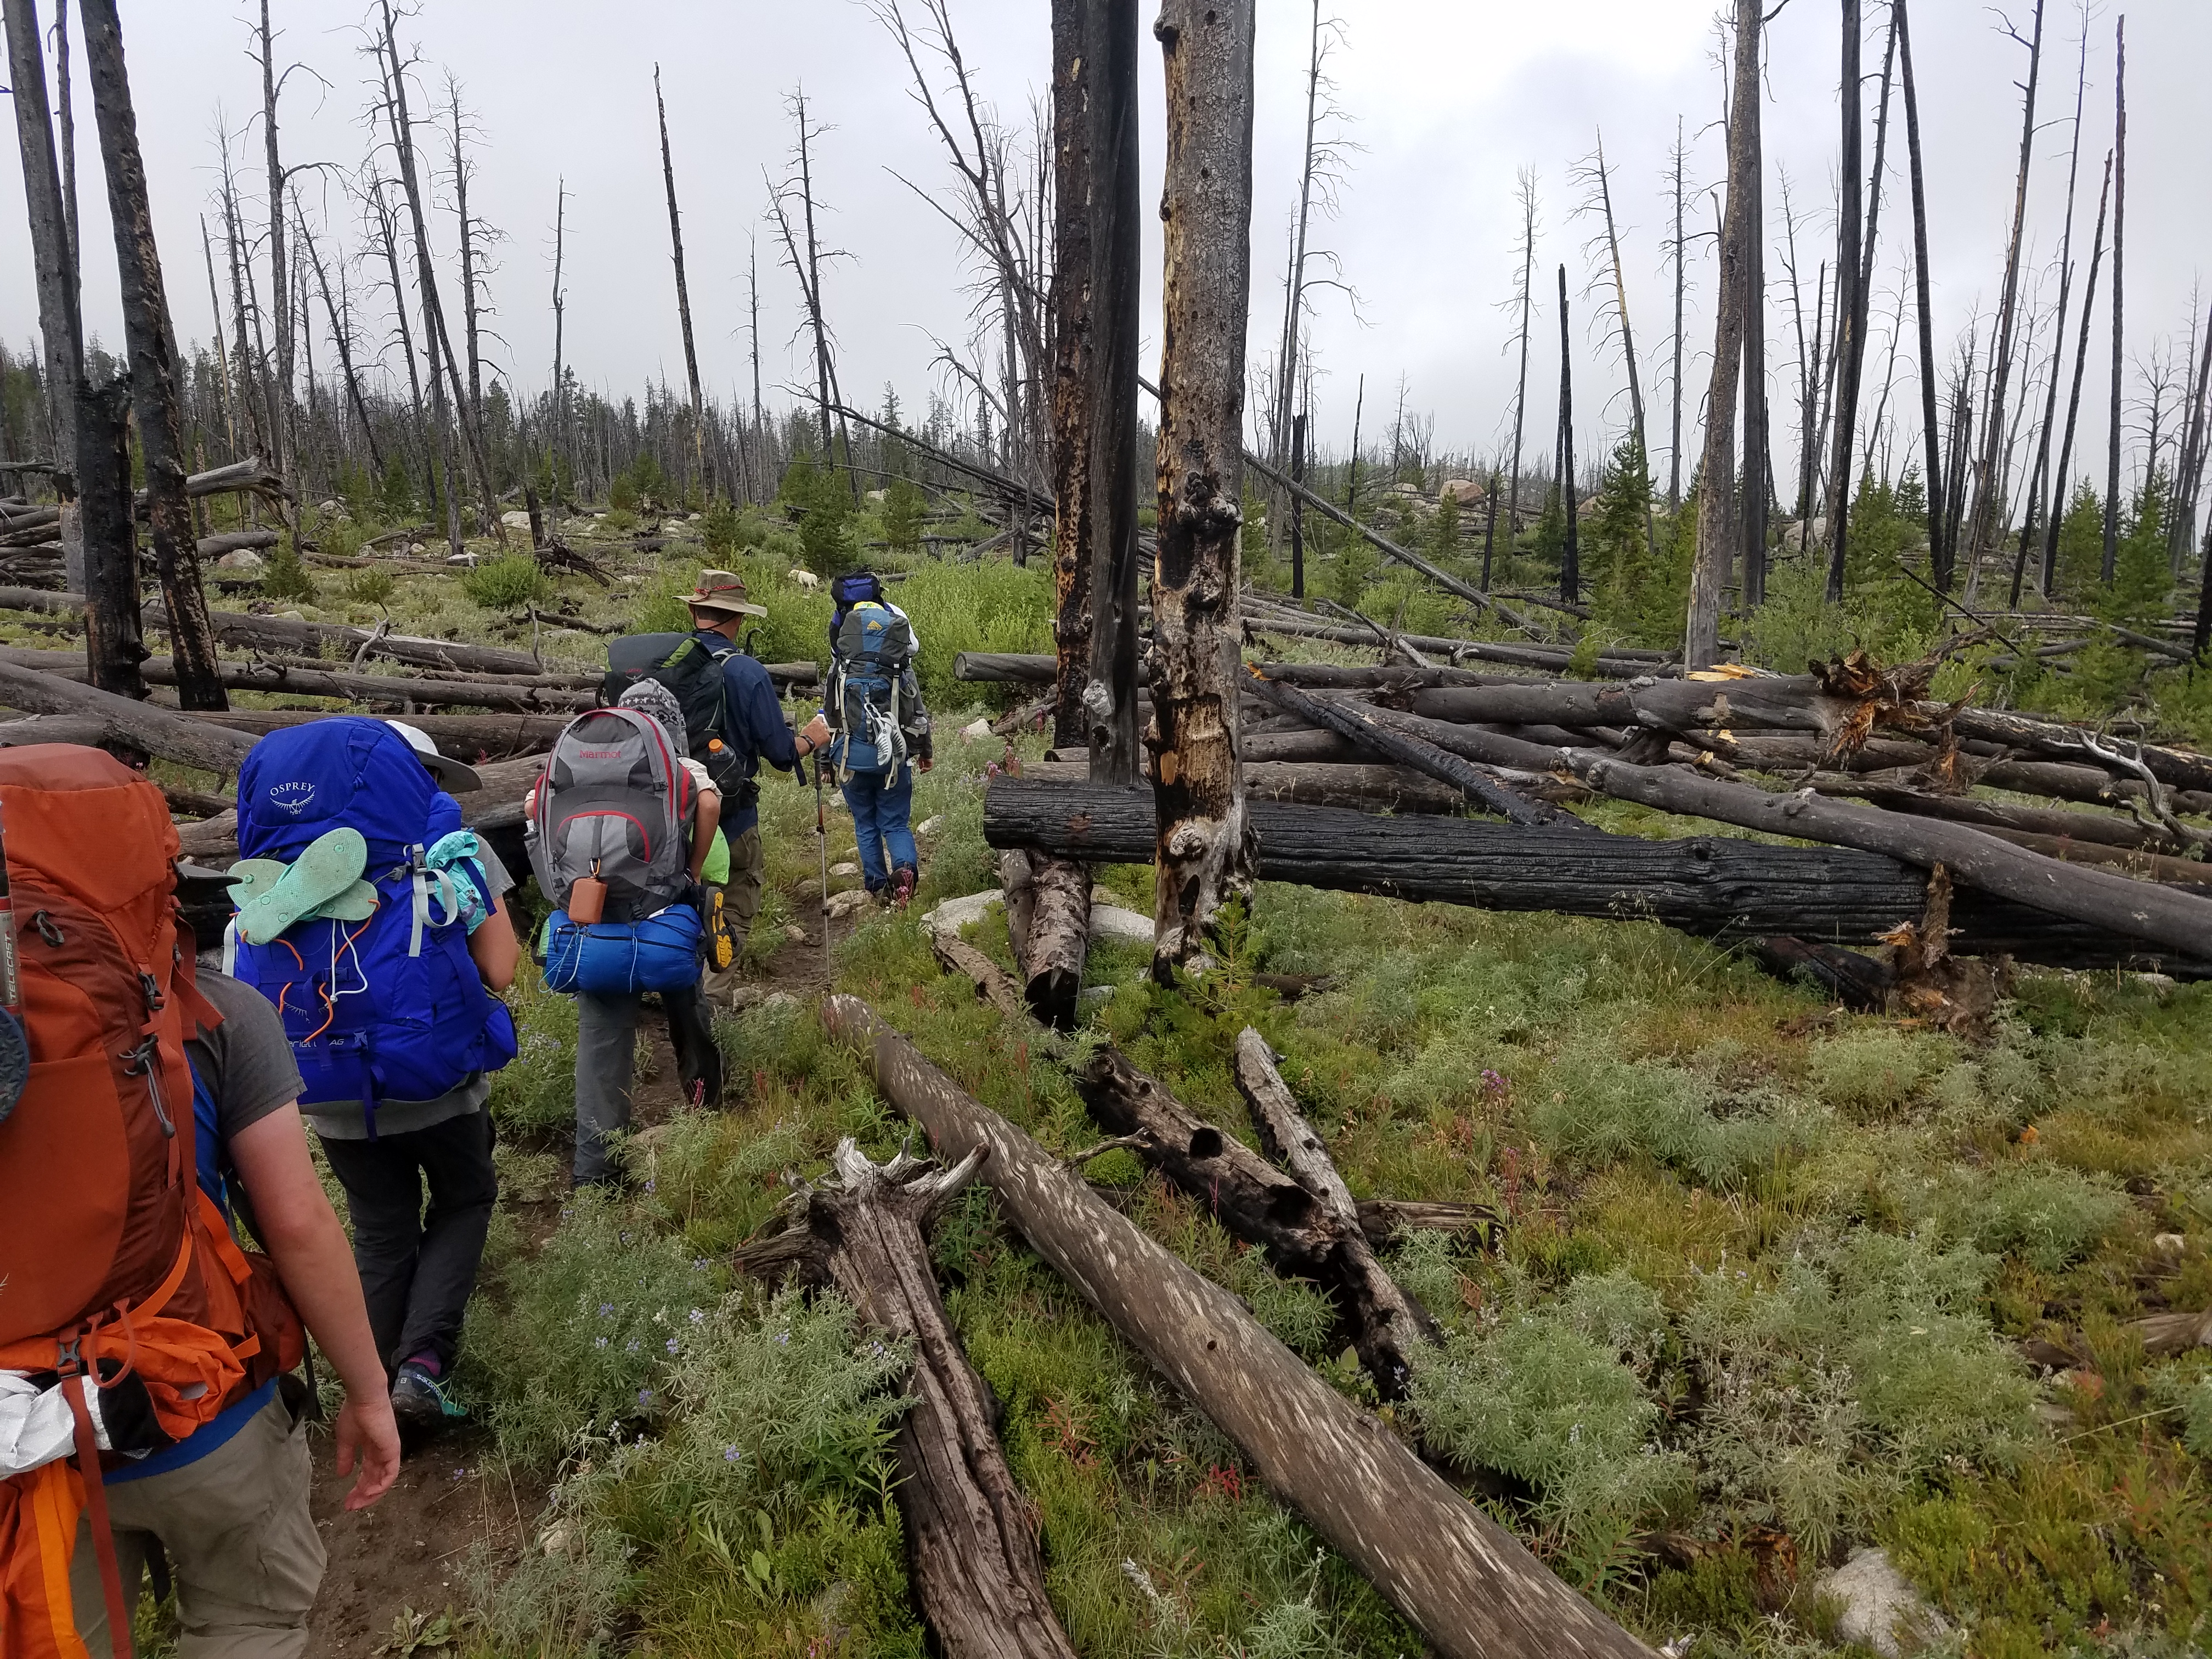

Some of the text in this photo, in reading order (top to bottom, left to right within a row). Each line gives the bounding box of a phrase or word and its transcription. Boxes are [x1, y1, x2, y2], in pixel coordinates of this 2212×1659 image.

[580, 750, 621, 758] Marmot
[270, 782, 316, 795] OSPREY
[5, 932, 16, 1000] TELECAST
